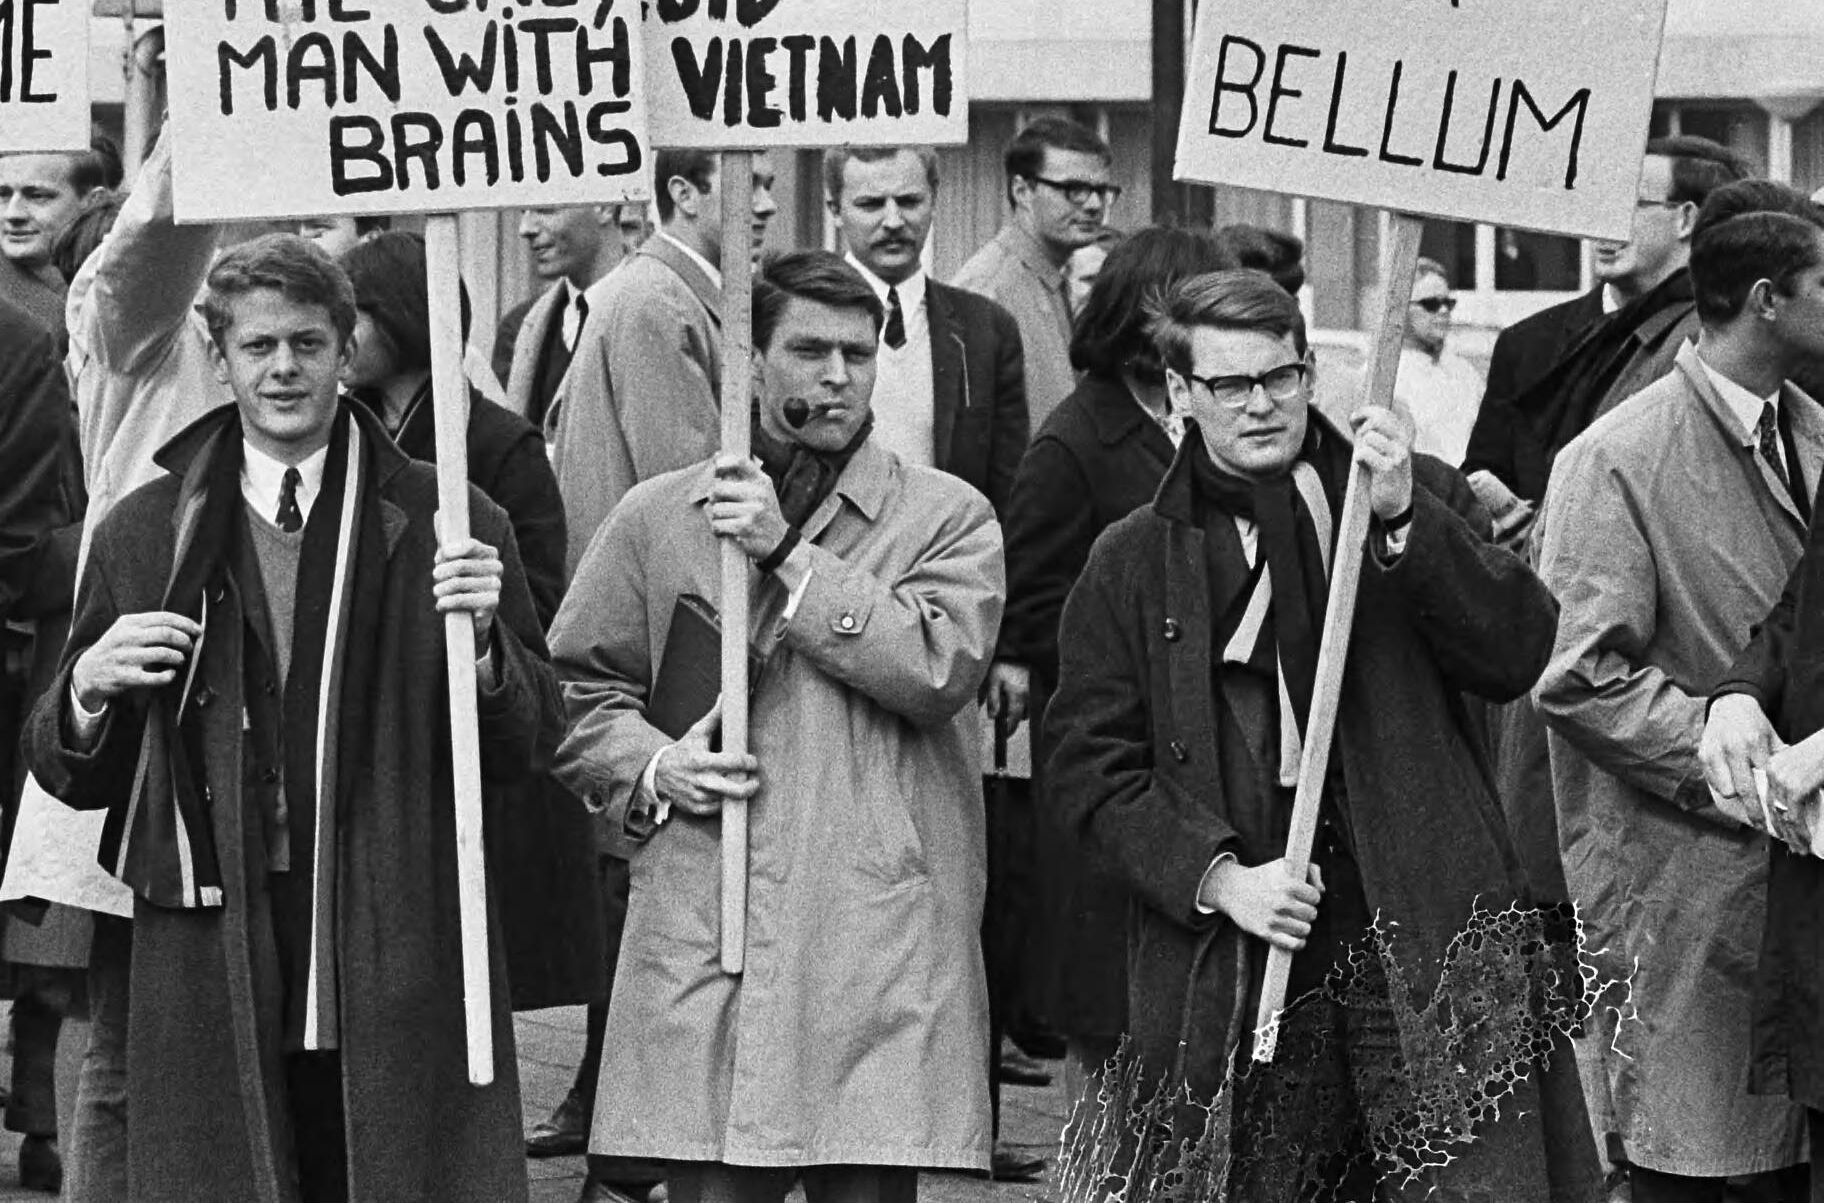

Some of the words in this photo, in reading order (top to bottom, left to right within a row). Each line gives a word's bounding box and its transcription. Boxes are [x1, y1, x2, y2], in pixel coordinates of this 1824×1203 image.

[216, 24, 402, 116] MAN
[671, 33, 952, 128] VIETNAM
[1208, 34, 1592, 191] BELLUM
